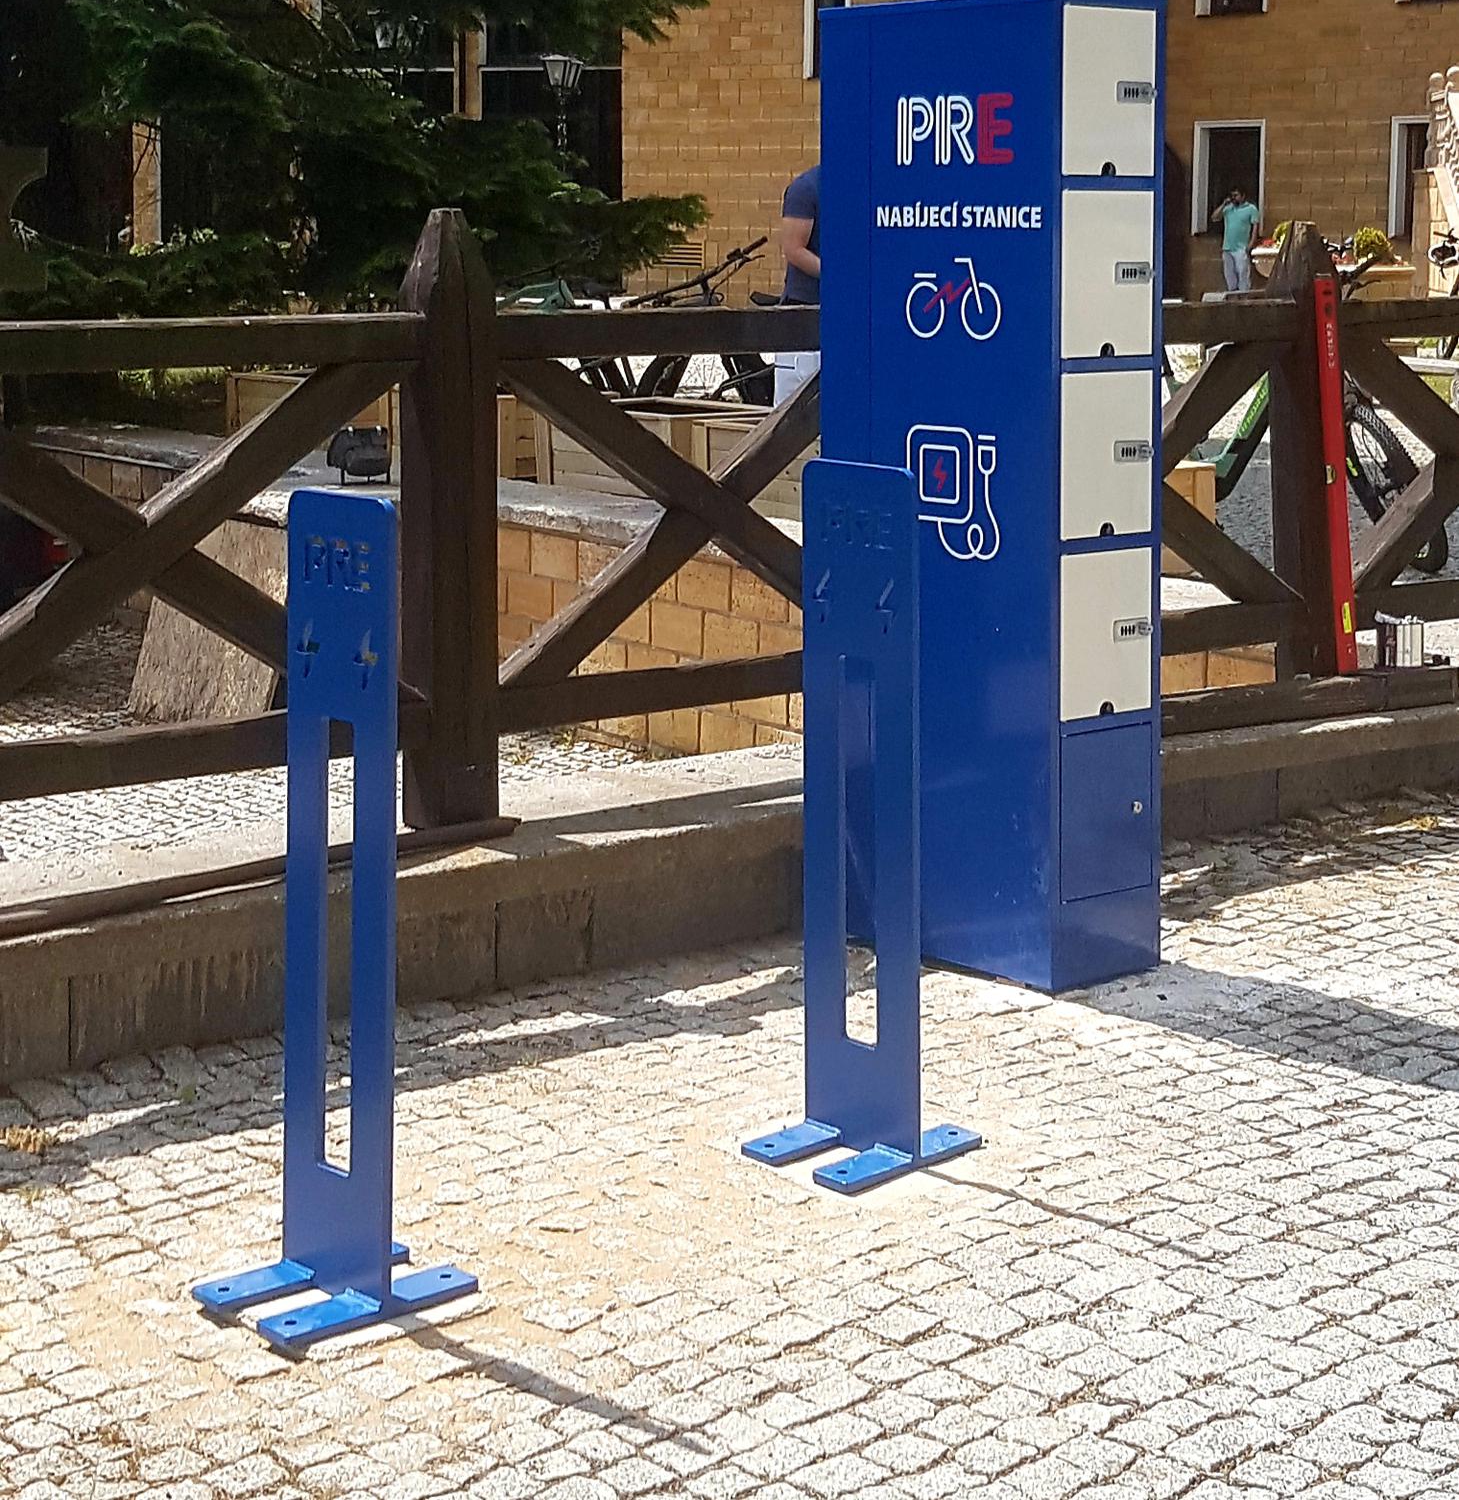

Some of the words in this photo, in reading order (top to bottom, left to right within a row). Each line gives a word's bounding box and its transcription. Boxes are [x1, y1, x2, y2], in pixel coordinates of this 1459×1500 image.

[896, 92, 1015, 166] PRE
[876, 201, 958, 228] NABÍJECÍ
[961, 205, 1042, 229] STANICE
[303, 534, 372, 593] PRE
